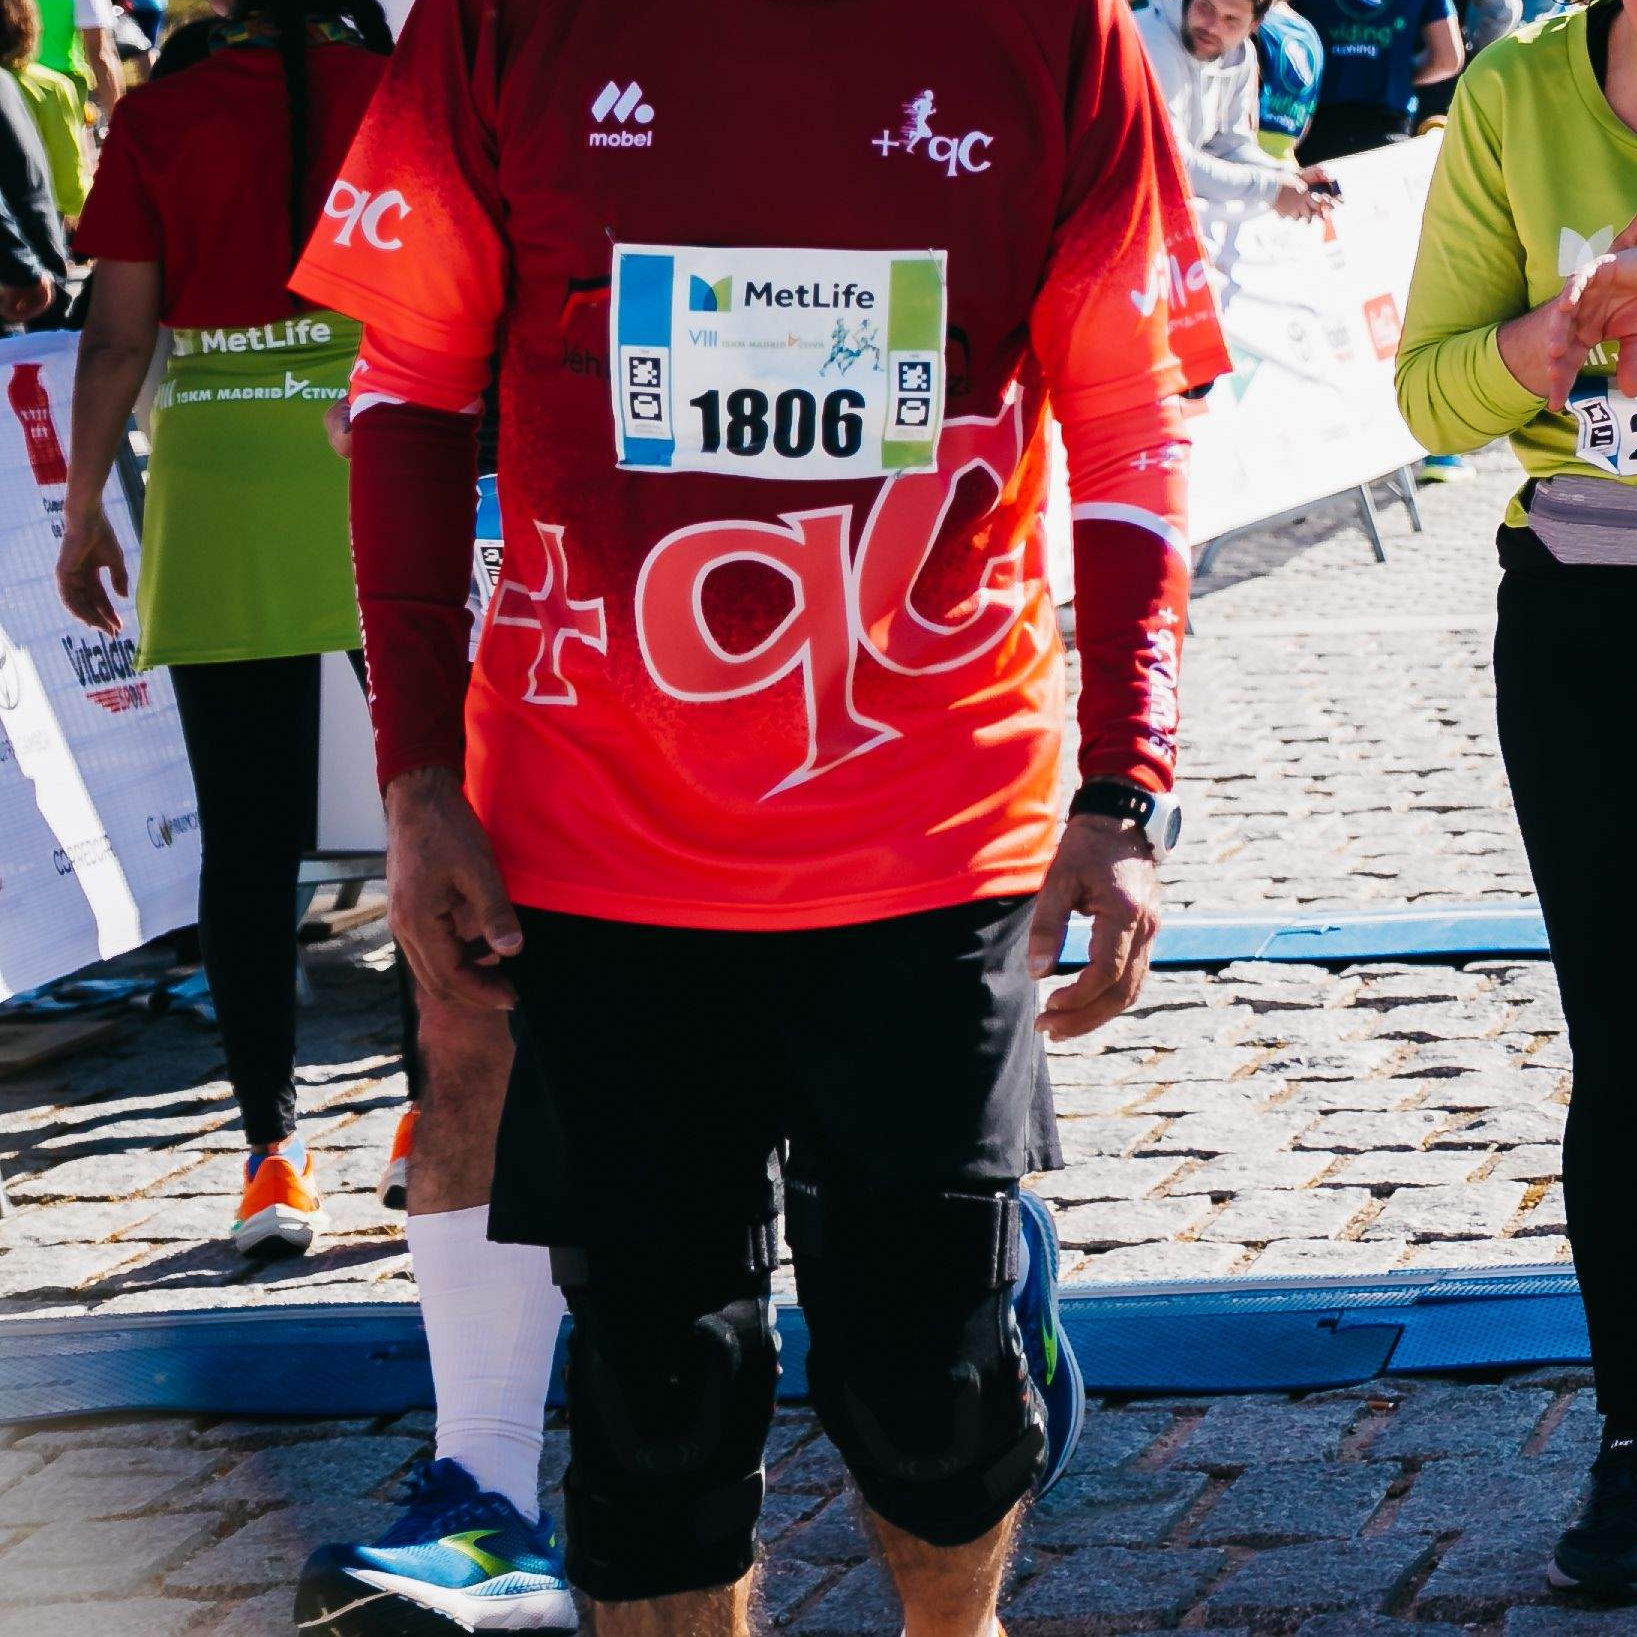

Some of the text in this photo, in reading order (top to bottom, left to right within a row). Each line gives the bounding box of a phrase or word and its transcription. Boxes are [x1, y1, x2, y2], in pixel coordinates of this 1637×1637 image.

[588, 129, 654, 148] mobel
[744, 280, 876, 310] MetLife
[200, 319, 332, 354] MetLife
[688, 329, 718, 348] VIII
[216, 387, 284, 400] MADRID
[689, 388, 866, 458] 1806
